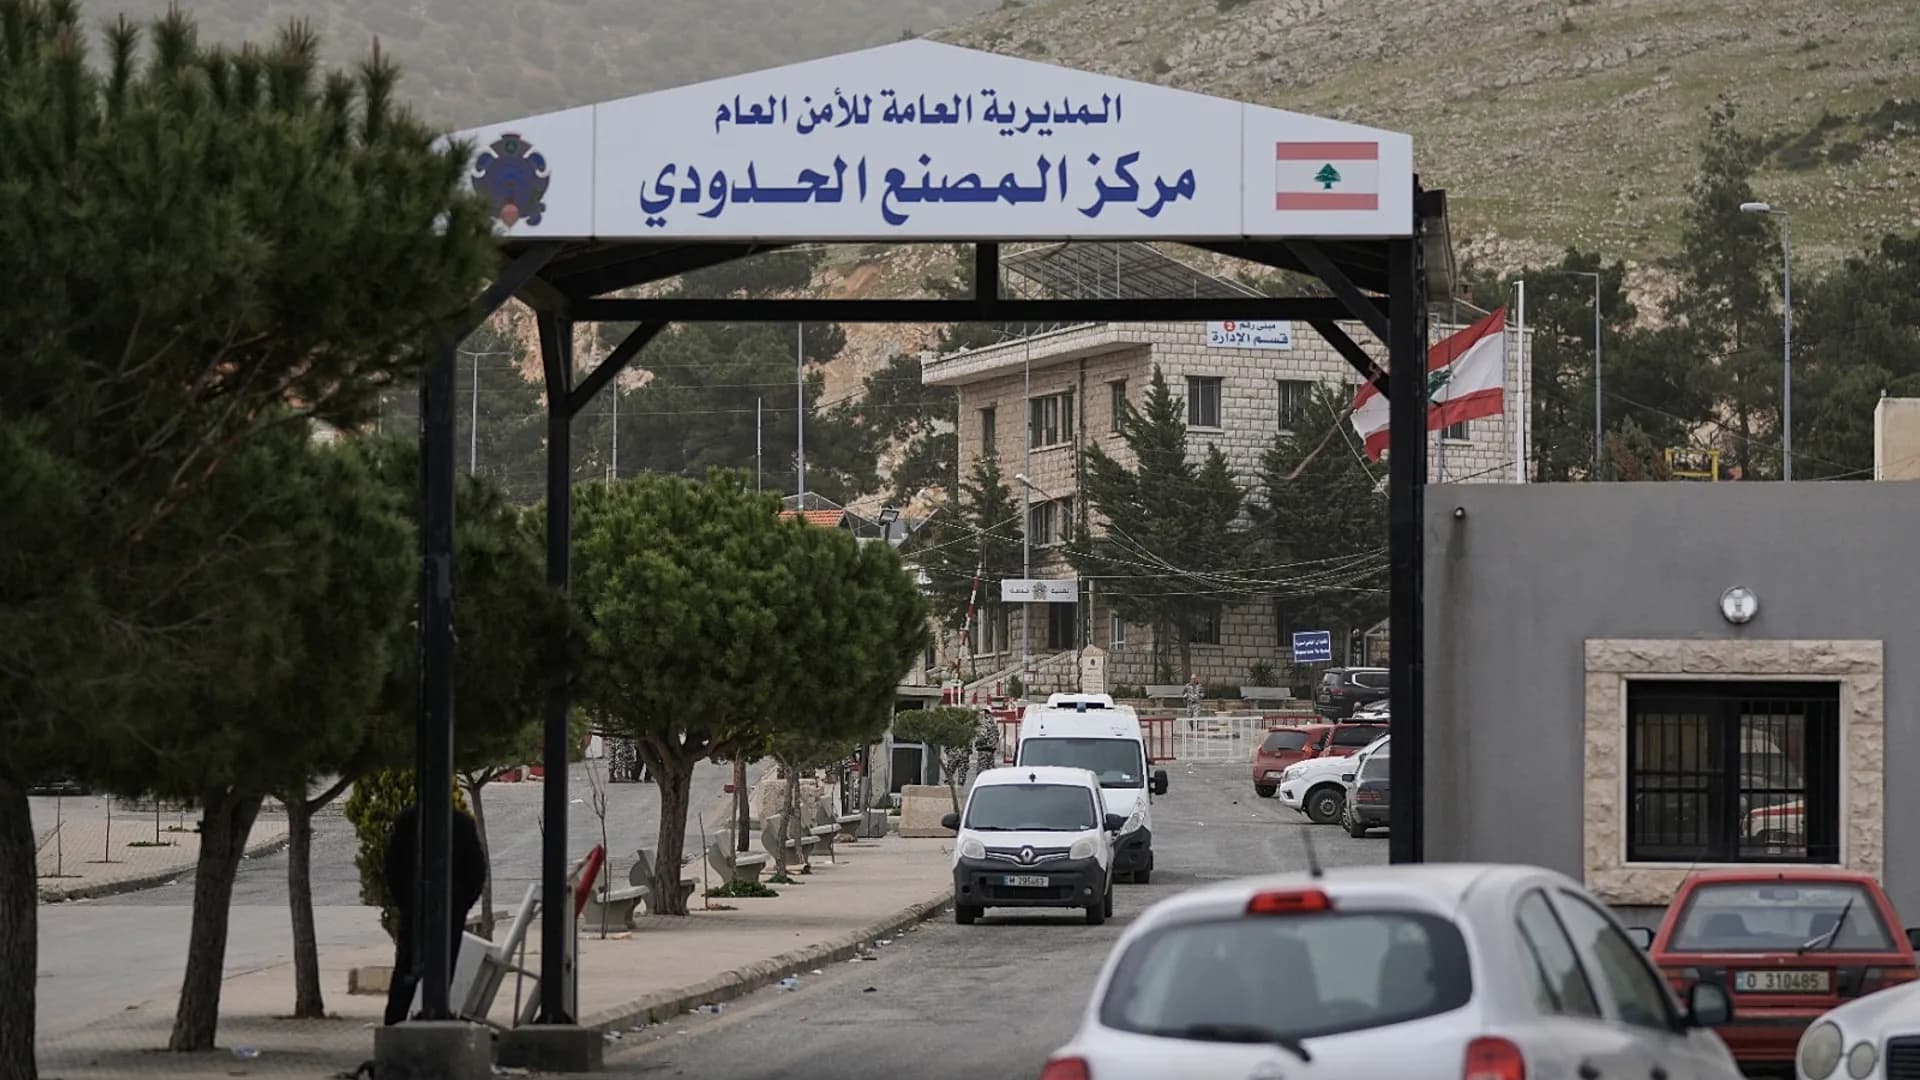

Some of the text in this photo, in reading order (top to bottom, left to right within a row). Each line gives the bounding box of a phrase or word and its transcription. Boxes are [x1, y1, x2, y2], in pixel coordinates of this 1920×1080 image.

[715, 86, 1122, 136] المديرية العامة للأمن العام
[640, 151, 1196, 228] مركز المصنع الحدودي
[1211, 331, 1289, 346] قسم الإدارة
[1765, 973, 1819, 989] 310485
